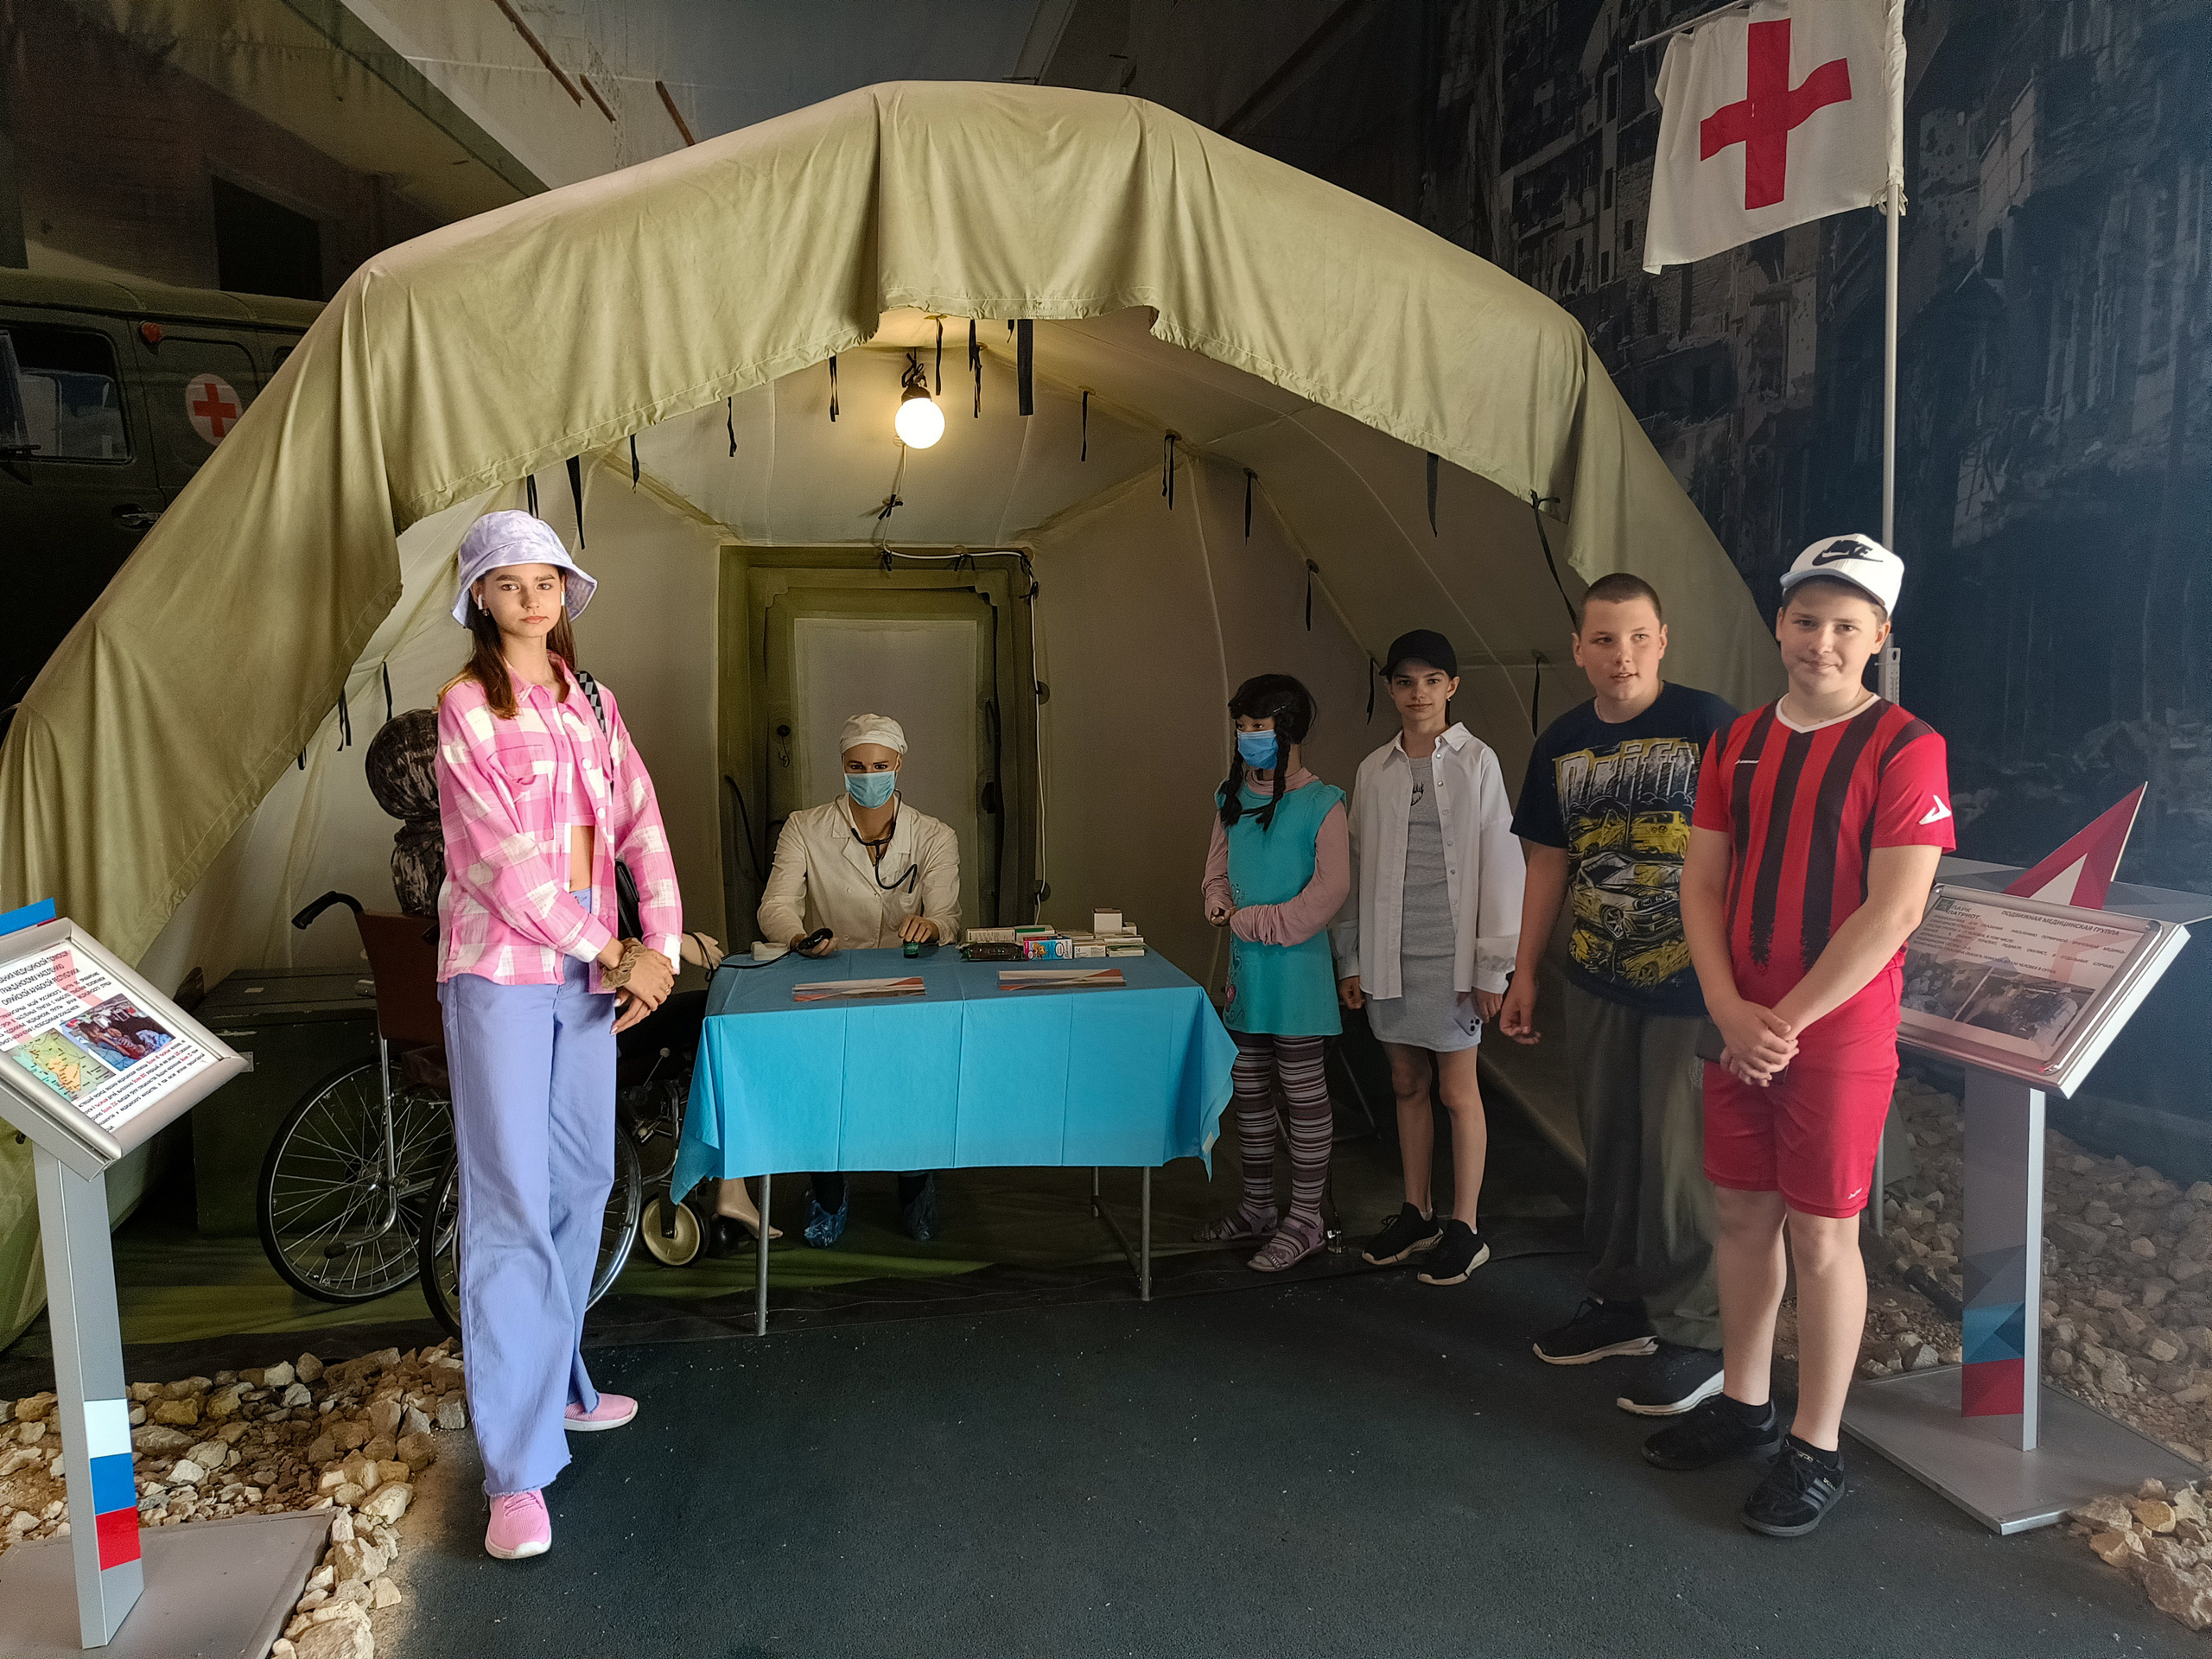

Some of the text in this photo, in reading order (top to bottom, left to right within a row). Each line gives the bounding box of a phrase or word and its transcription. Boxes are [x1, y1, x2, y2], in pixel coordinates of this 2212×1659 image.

[1559, 741, 1694, 808] Drift
[1946, 910, 1980, 919] ПАТРИОТ
[1999, 910, 2120, 936] ПОДВИЖНАЯ МЕДИЦИНСКАЯ ГРУППА
